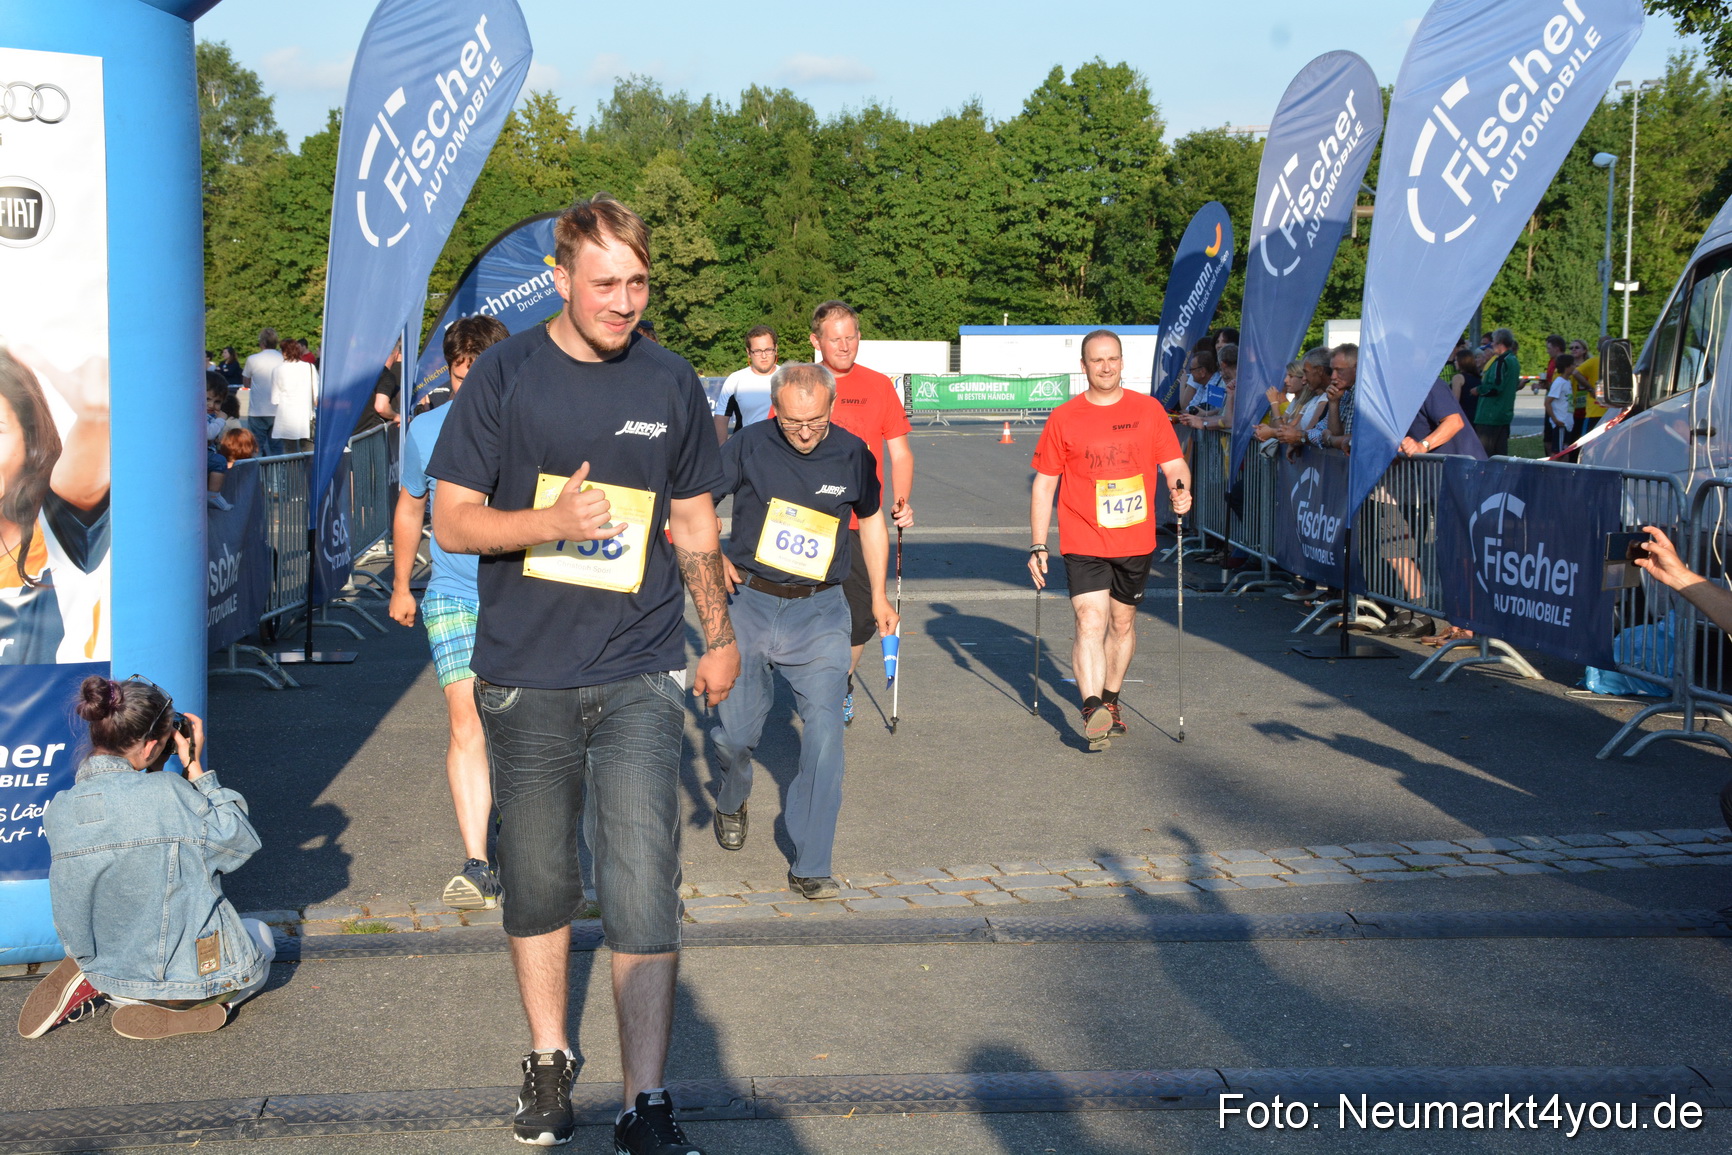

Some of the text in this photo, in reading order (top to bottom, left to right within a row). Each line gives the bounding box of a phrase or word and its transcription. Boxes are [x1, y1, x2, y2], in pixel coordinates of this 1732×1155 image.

[383, 13, 492, 214] Fischer
[1441, 0, 1586, 207] Fischer
[1491, 25, 1602, 203] AUTOMOBILE
[422, 56, 503, 214] AUTOMOBILE
[1279, 88, 1357, 250] Fischer
[1305, 120, 1364, 248] AUTOMOBILE
[517, 292, 544, 312] Druck
[1161, 261, 1213, 357] Frischmann
[948, 382, 1010, 392] GESUNDHEIT
[1029, 380, 1065, 397] AOK
[987, 392, 1015, 401] HÄNDEN
[1103, 495, 1142, 514] 1472
[1297, 500, 1341, 543] Fischer
[776, 530, 819, 559] 683
[1484, 536, 1579, 597] Fischer
[1493, 593, 1572, 627] AUTOMOBILE
